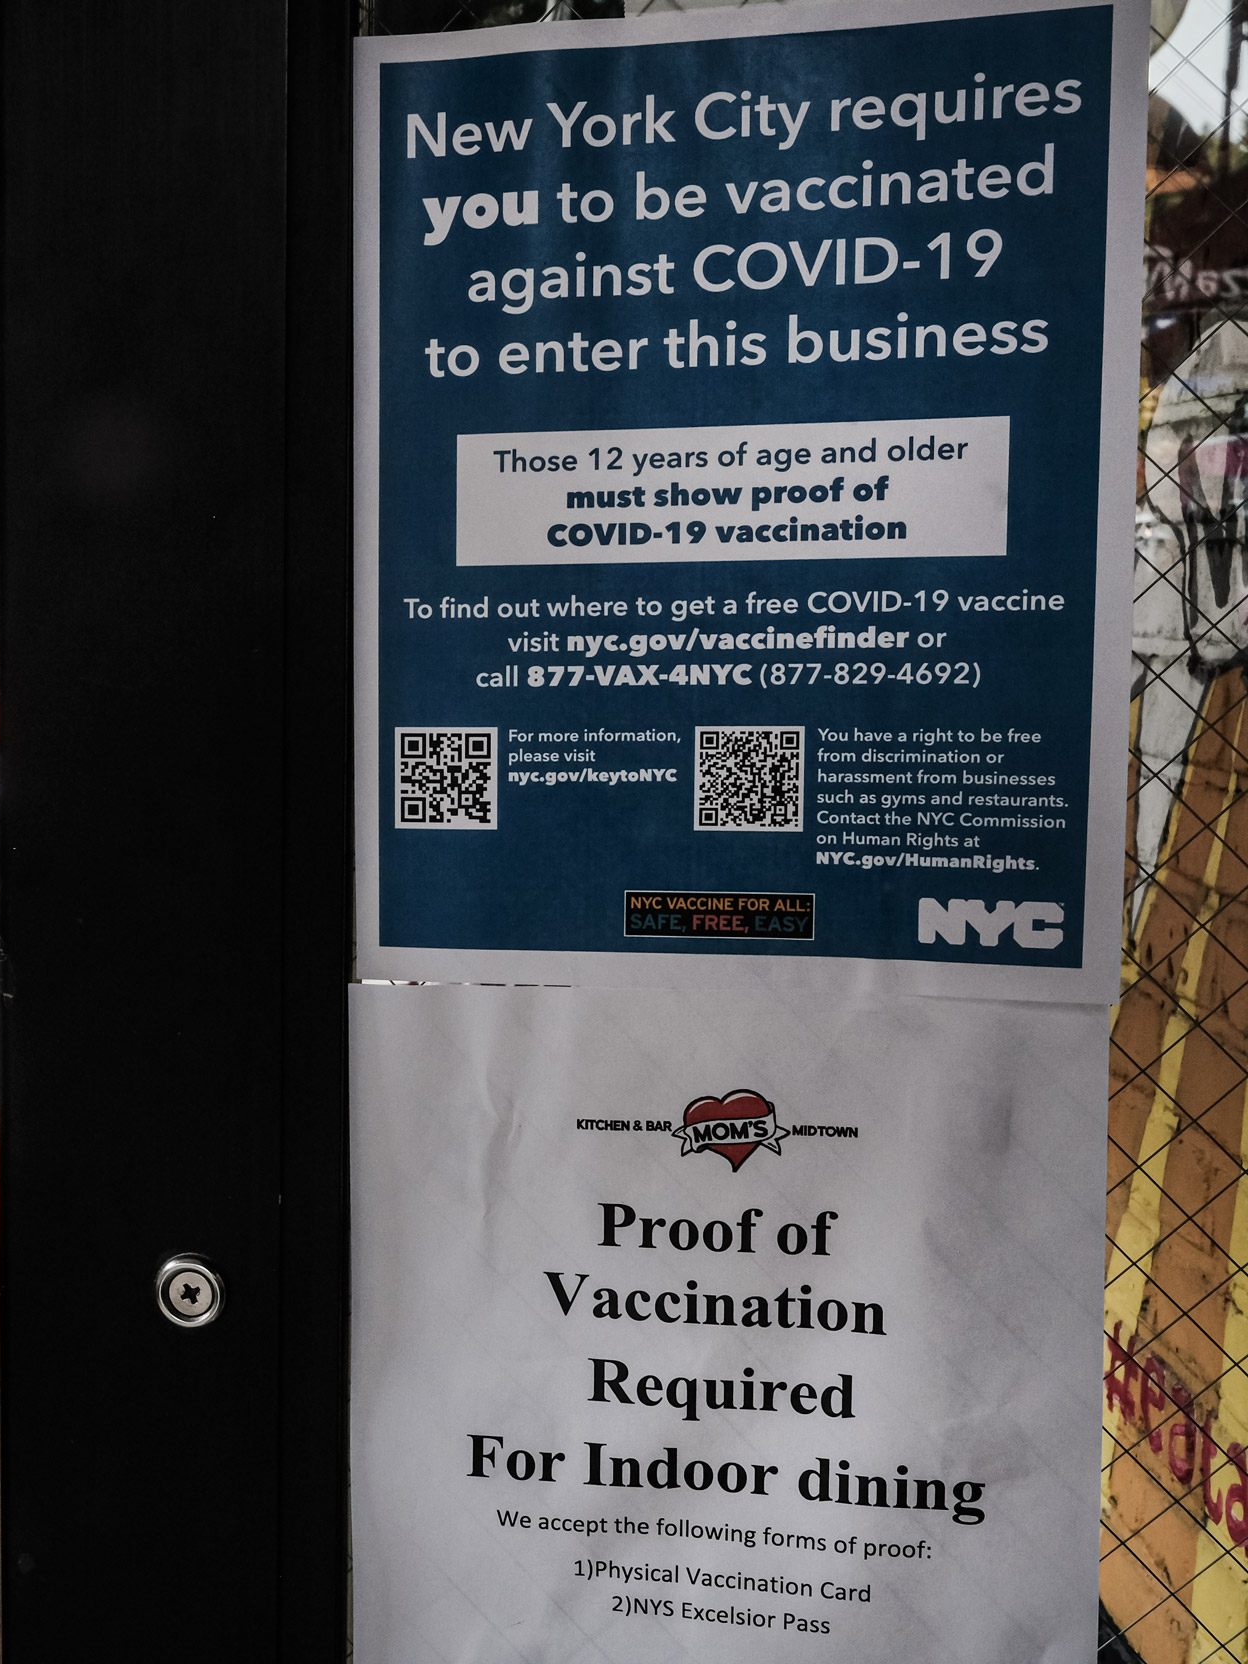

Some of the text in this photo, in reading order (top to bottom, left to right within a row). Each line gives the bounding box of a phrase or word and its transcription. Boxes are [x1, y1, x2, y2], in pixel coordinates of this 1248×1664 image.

[407, 73, 1081, 158] New York City requires
[422, 143, 1054, 245] you to be vaccinated
[468, 229, 1002, 314] against COVID-19
[425, 312, 1048, 377] to enter this business
[494, 436, 968, 476] Those 12 years of age and older
[567, 476, 889, 511] must show proof of
[547, 515, 906, 547] COVID-19 vaccination
[404, 589, 1064, 621] To find out where to get a free COVID-19 vaccine
[508, 625, 946, 657] visit nyc.gov/vaccinefinder or
[476, 662, 980, 688] call 877-VAX-4NYC (877-829-4692)
[509, 728, 680, 743] For more information,
[818, 728, 1042, 745] You have a right to be free
[509, 749, 595, 765] please visit
[817, 748, 1004, 763] from discrimination or
[509, 768, 677, 785] nyc.gov/keytoNYC
[818, 769, 1055, 785] harassment from businesses
[817, 789, 1068, 808] such as gyms and restaurants.
[817, 811, 1065, 828] Contact the NYC Commission
[817, 832, 980, 850] on Human Rights at
[816, 852, 1039, 872] NYC.gov/HumanRights.
[631, 897, 809, 911] NYC VACCINE FOR ALL:
[631, 914, 808, 933] SAFE, FREE, EASY
[918, 898, 1064, 949] NYC
[577, 1119, 672, 1131] KITCHEN & BAR
[692, 1120, 768, 1143] MOM'S
[792, 1125, 858, 1138] MIDTOWN
[598, 1203, 838, 1255] Proof of
[543, 1272, 887, 1335] Vaccination
[588, 1358, 855, 1421] Required
[467, 1435, 985, 1525] For Indoor dining
[497, 1510, 931, 1560] We accept the following forms of proof:
[575, 1559, 870, 1602] 1)Physical Vaccination Card
[613, 1596, 830, 1634] 2)NYS Excelsior Pass
